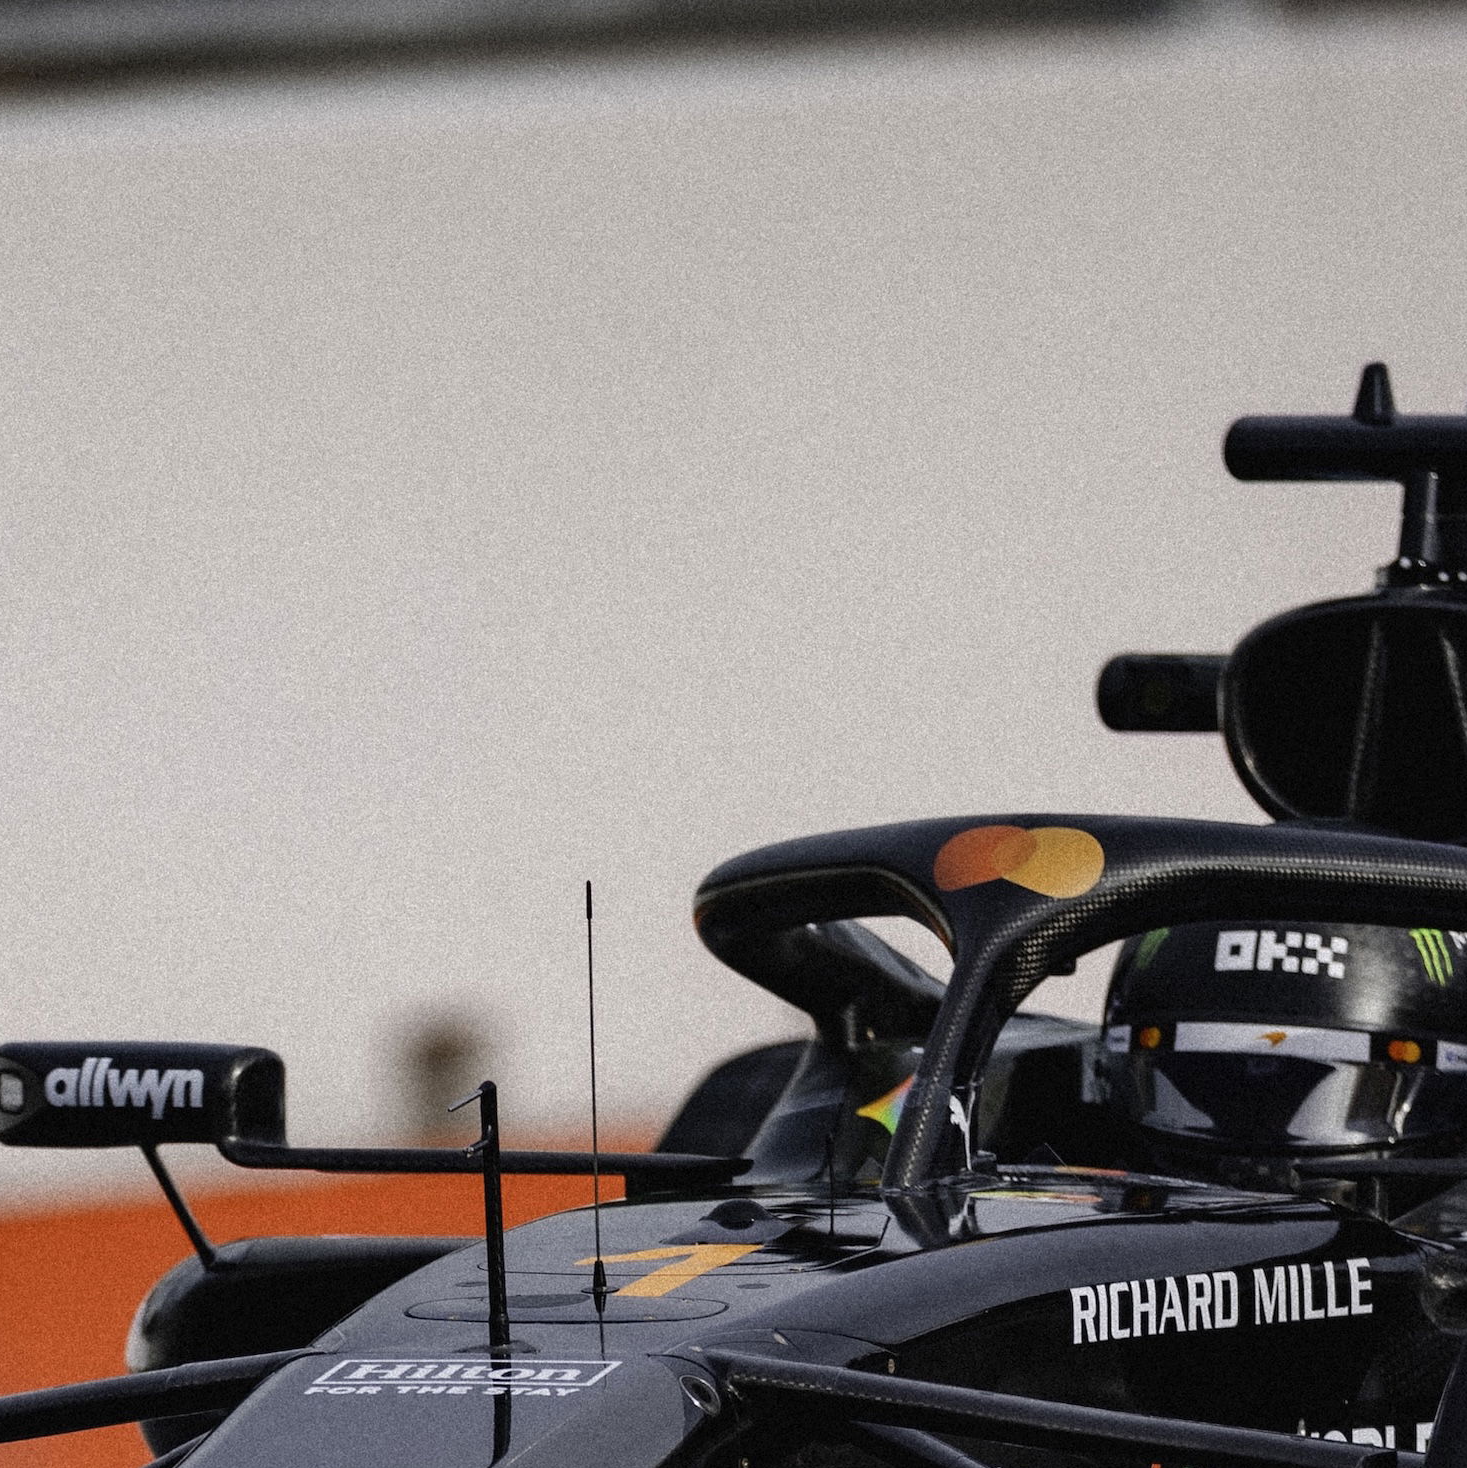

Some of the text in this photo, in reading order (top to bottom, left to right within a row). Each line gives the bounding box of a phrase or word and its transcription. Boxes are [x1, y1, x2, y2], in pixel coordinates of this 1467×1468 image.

[1214, 929, 1350, 979] OKX
[44, 1056, 205, 1120] allwyn
[1069, 1257, 1374, 1345] RICHARD MILLE
[303, 1386, 582, 1397] FOR THE STAY
[343, 1363, 583, 1381] Hilton
